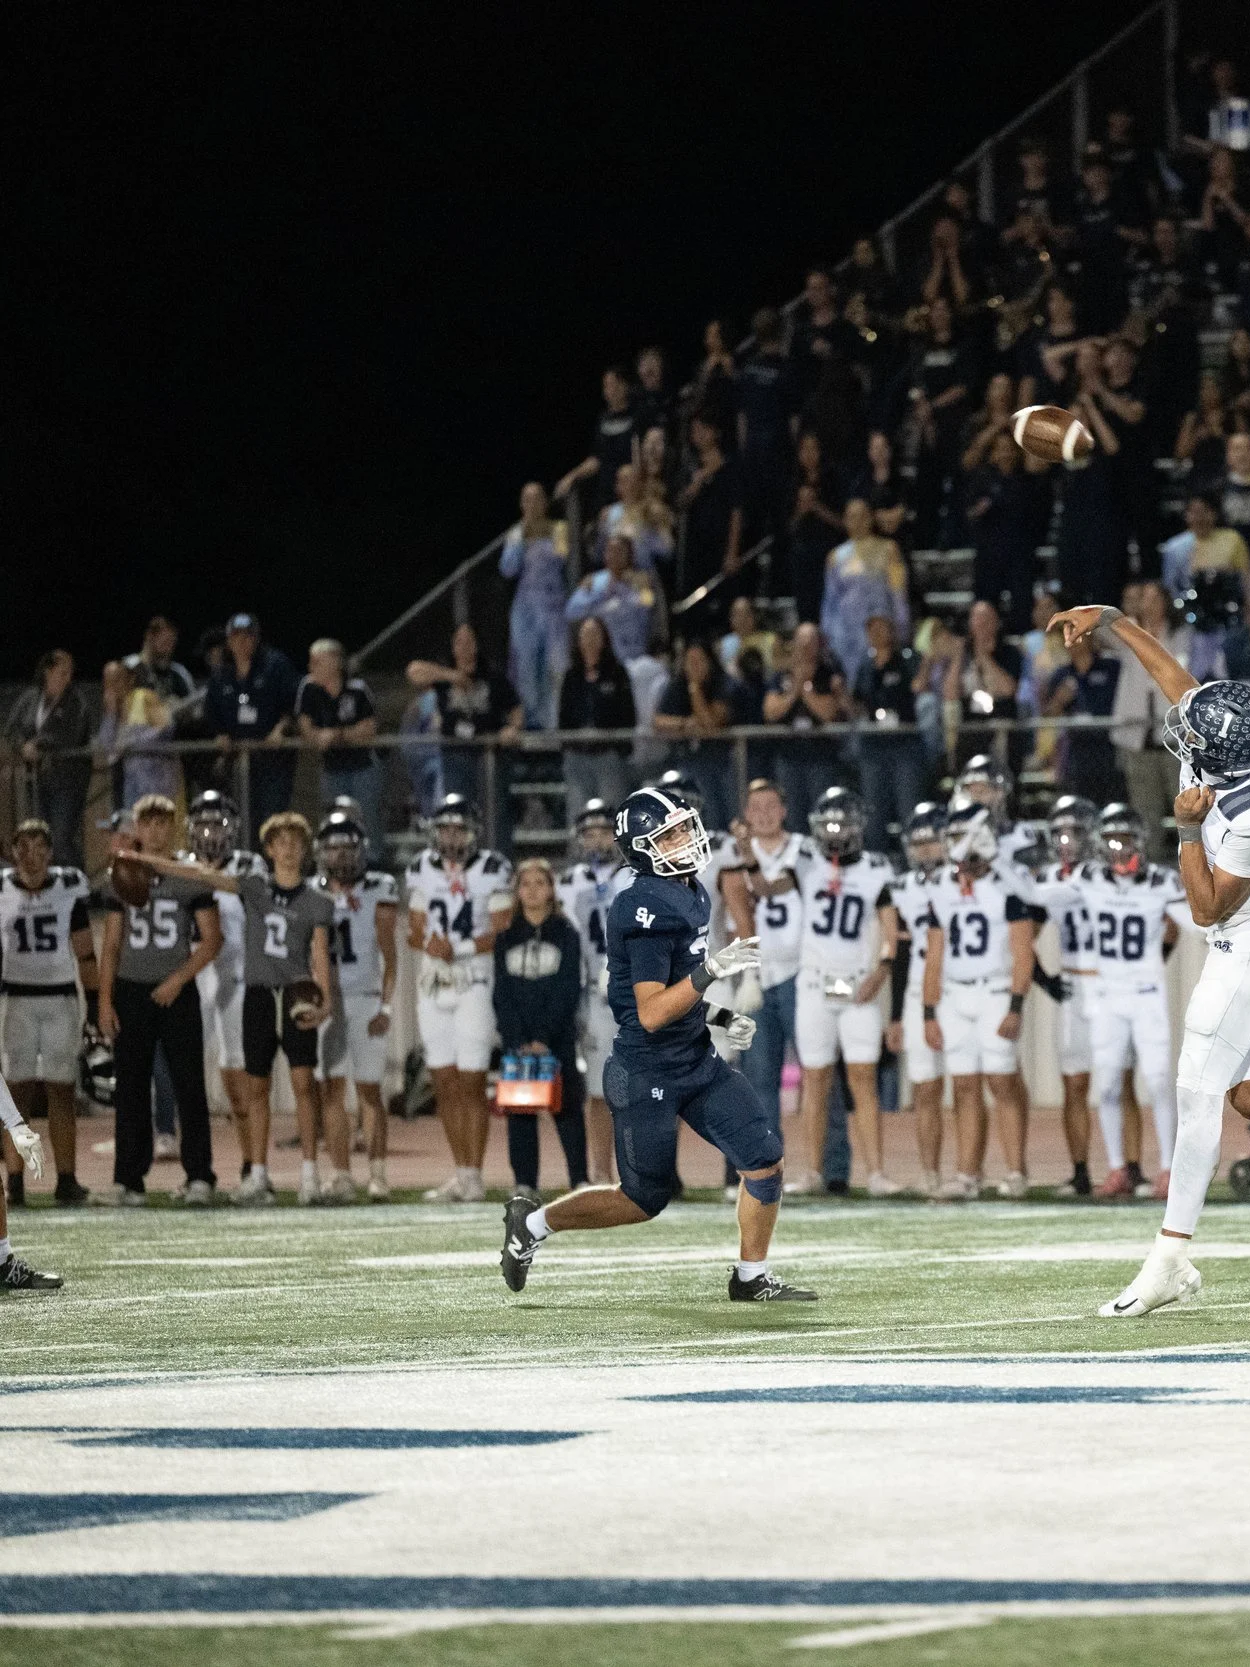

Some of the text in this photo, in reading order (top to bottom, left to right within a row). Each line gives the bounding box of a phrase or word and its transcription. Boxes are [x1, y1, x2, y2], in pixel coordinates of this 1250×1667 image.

[1218, 713, 1233, 739] 1
[616, 808, 629, 837] 31
[13, 914, 58, 952] 15
[129, 900, 178, 949] 55
[635, 906, 656, 929] SV
[812, 890, 864, 939] 30
[264, 913, 288, 958] 2
[1099, 912, 1145, 960] 28
[651, 1087, 664, 1101] SV
